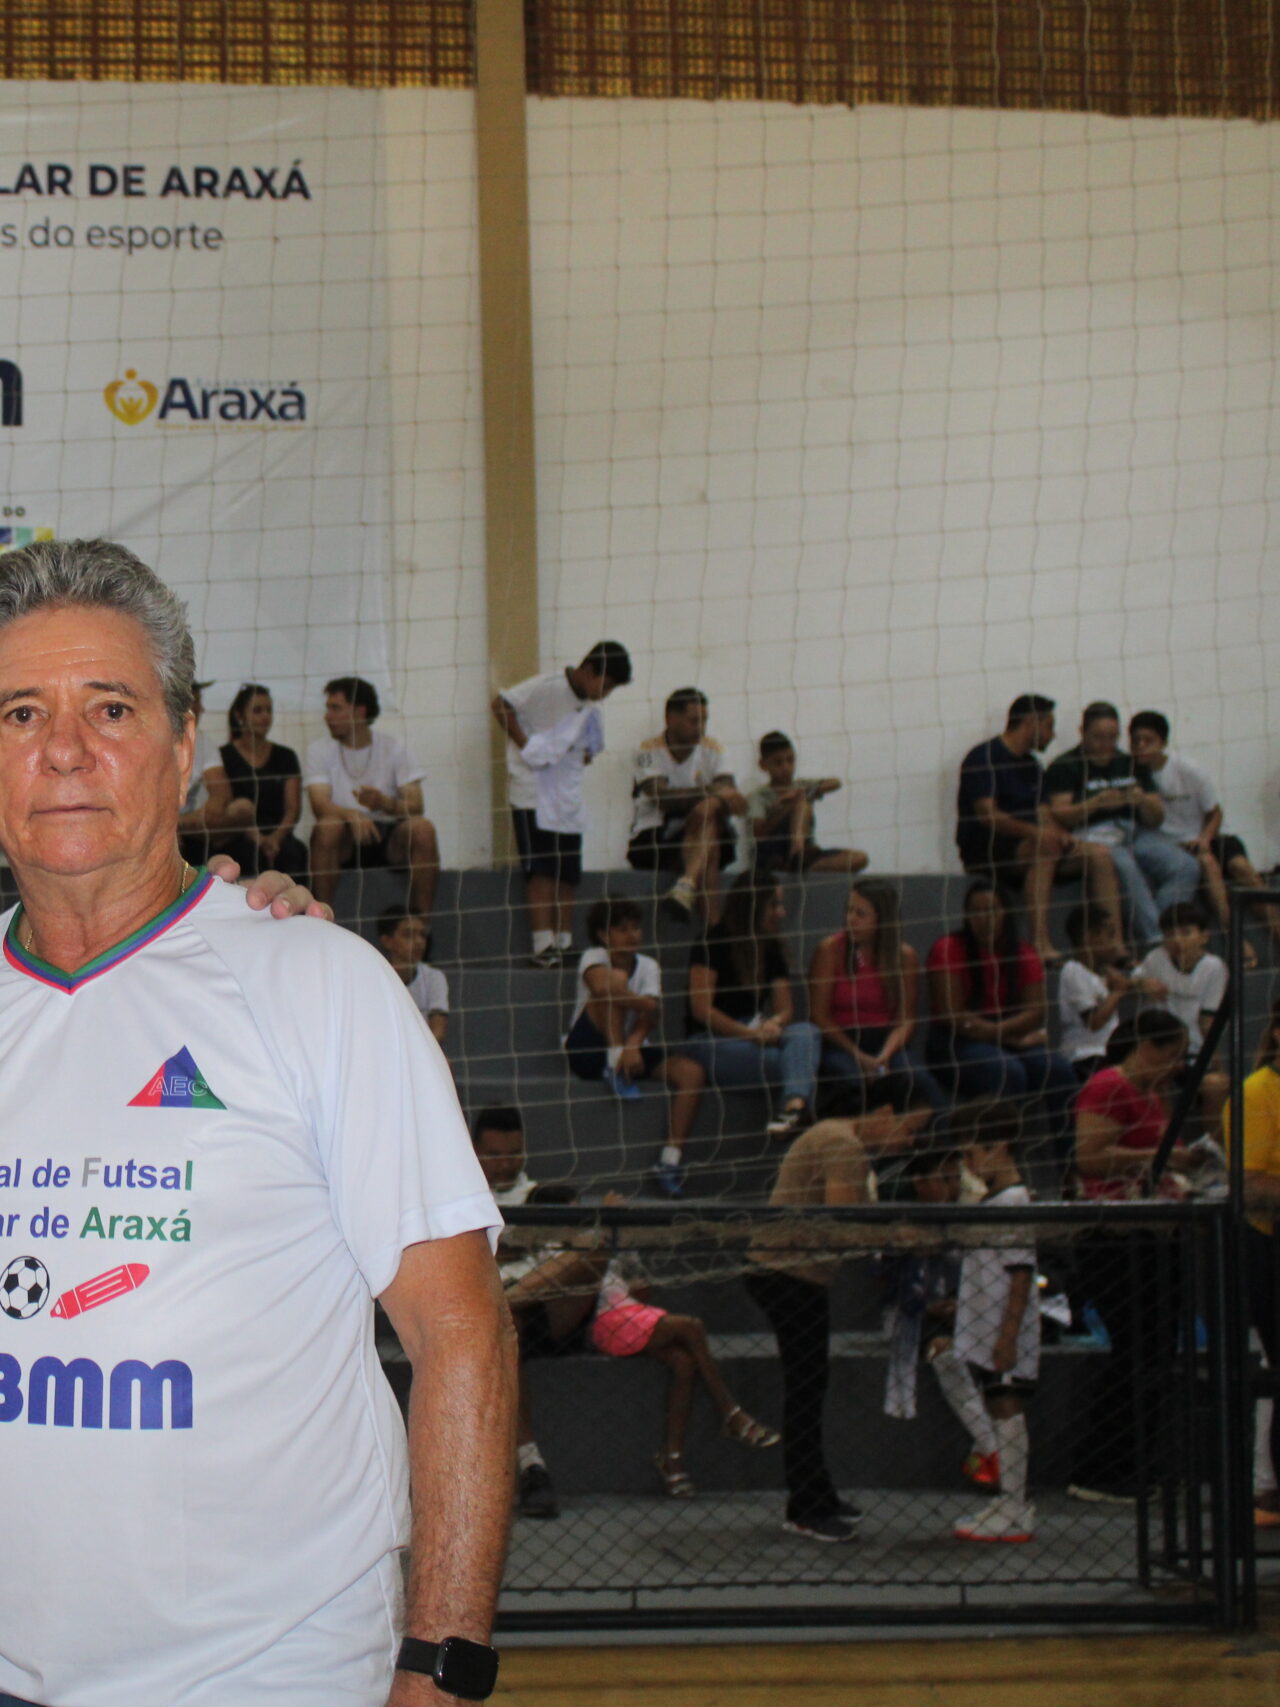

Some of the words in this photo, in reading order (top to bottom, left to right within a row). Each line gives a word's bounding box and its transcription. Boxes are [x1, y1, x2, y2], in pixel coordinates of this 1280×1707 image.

[88, 164, 147, 197] DE
[160, 159, 312, 200] ARAXÁ
[28, 217, 75, 250] do
[86, 222, 224, 255] esporte
[158, 377, 307, 422] Araxá
[2, 506, 27, 518] DO
[147, 1076, 209, 1097] AEC
[31, 1158, 71, 1188] de
[81, 1157, 193, 1192] Futsal
[28, 1206, 70, 1239] de
[79, 1206, 192, 1243] Araxá
